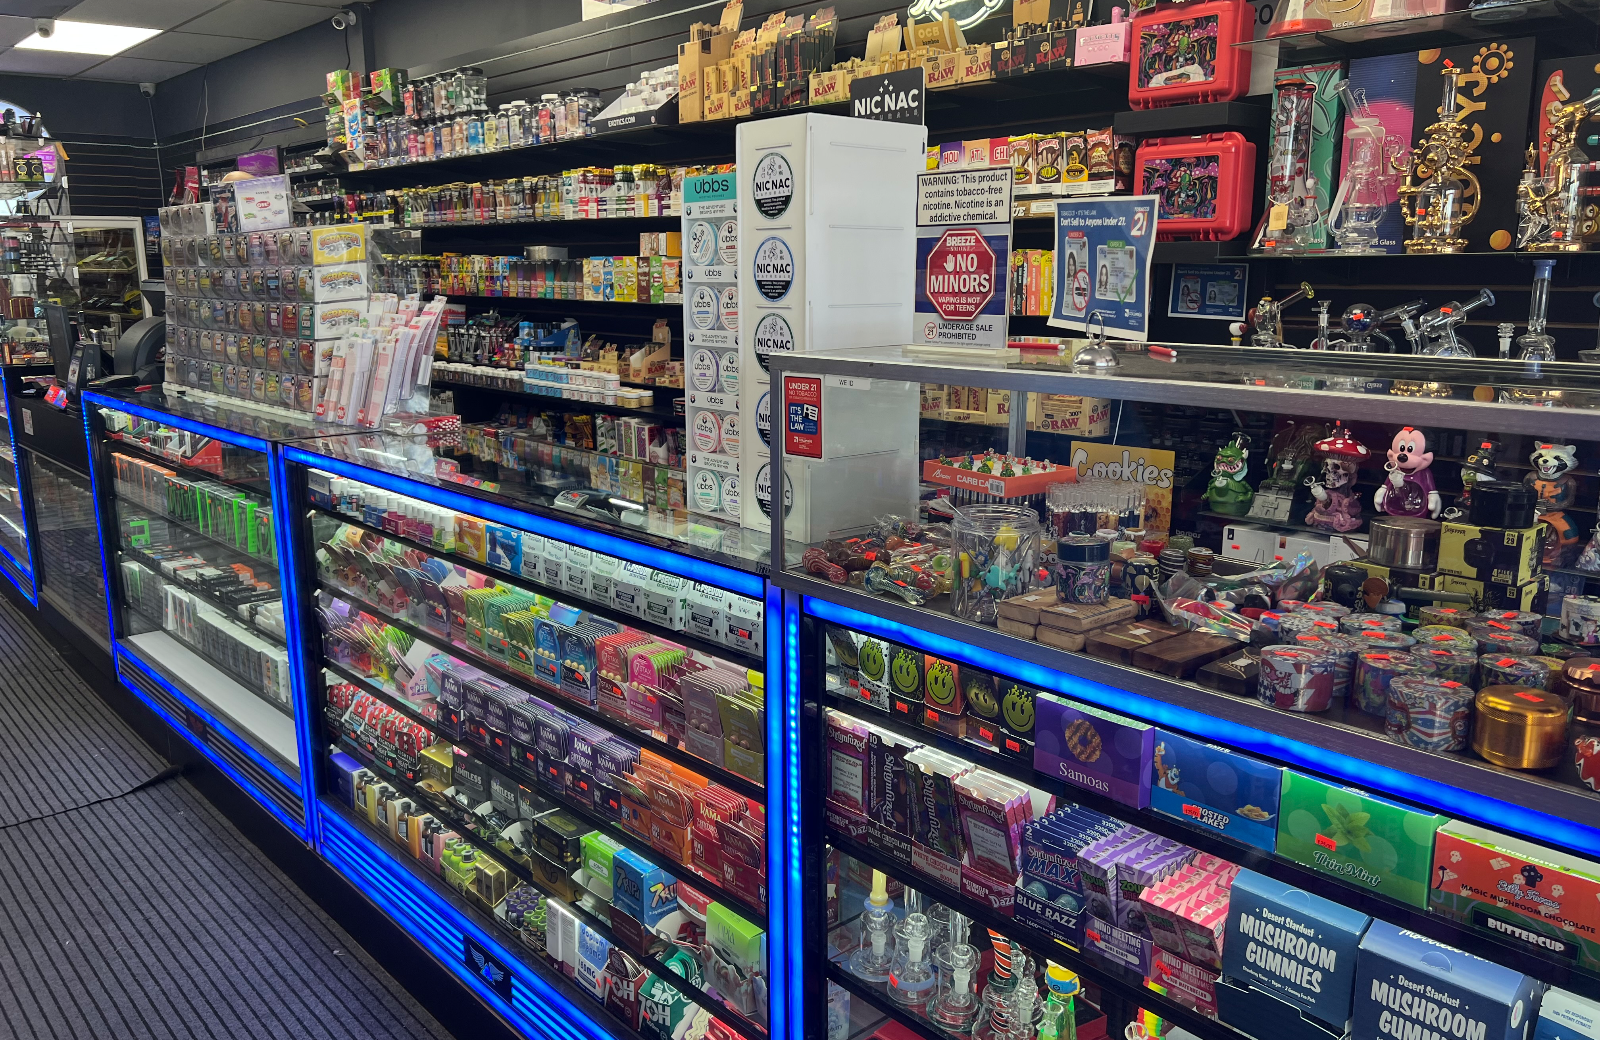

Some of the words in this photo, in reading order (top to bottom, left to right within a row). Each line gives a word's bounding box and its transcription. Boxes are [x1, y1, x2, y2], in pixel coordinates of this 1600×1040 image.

[874, 19, 897, 34] RAW
[918, 27, 939, 38] OCB
[733, 34, 755, 51] RAW
[1035, 45, 1068, 64] RAW
[965, 59, 991, 77] RAW
[997, 54, 1027, 71] RAW
[927, 66, 956, 84] RAW
[679, 79, 697, 96] RAW
[814, 82, 836, 98] RAW
[854, 96, 882, 116] NIC
[884, 89, 919, 111] NAC
[707, 103, 724, 118] RAW
[943, 150, 959, 165] HOU
[970, 148, 987, 162] ATL
[993, 147, 1009, 160] CHI
[755, 181, 770, 194] NIC
[771, 178, 790, 190] NAC
[921, 175, 959, 188] WARNING:
[961, 174, 976, 184] This
[978, 172, 1007, 185] product
[925, 188, 955, 198] contains
[956, 185, 1003, 196] tobacco-free
[923, 201, 953, 212] nicotine.
[954, 199, 985, 210] Nicotine
[986, 199, 993, 208] is
[993, 199, 1004, 208] an
[929, 211, 961, 223] addictive
[963, 210, 998, 221] chemical.
[1060, 217, 1071, 226] Don't
[1071, 216, 1080, 226] Sell
[1080, 217, 1085, 226] to
[1085, 217, 1103, 228] Anyone
[1103, 216, 1118, 226] Under
[1118, 216, 1127, 226] 21.
[319, 231, 361, 248] SCRATCH
[946, 235, 976, 247] BREEZE
[756, 263, 771, 274] NIC
[772, 263, 791, 274] NAC
[957, 253, 978, 271] NO
[320, 271, 362, 285] SCRATCH
[930, 273, 990, 294] MINORS
[938, 295, 960, 305] VAPING
[961, 296, 966, 304] IS
[967, 296, 980, 305] NOT
[320, 307, 360, 321] SCRATCH
[942, 303, 954, 312] FOR
[955, 303, 975, 313] TEENS
[938, 322, 973, 333] UNDERAGE
[975, 323, 993, 332] SALE
[938, 331, 977, 341] PROHIBITED
[757, 338, 772, 350] NIC
[772, 339, 791, 351] NAC
[648, 364, 667, 374] RAW
[788, 382, 810, 391] UNDER
[811, 382, 817, 391] 21
[796, 390, 818, 398] TOBACCO
[790, 406, 802, 414] IT'S
[921, 399, 941, 412] RAW
[790, 414, 803, 422] THE
[1088, 408, 1110, 424] RAW
[790, 422, 805, 431] LAW
[1050, 417, 1080, 431] RAW
[1072, 447, 1172, 489] Cookies
[957, 474, 978, 487] CARB
[1506, 537, 1515, 545] 29
[869, 732, 878, 744] 10
[904, 761, 914, 772] 10
[455, 765, 482, 787] LIMITLESS
[1059, 761, 1109, 794] Samoas
[490, 782, 516, 803] LIMITLESS
[1025, 826, 1033, 838] 2
[1027, 857, 1079, 887] MAX
[1313, 850, 1345, 876] Thin
[1345, 861, 1383, 888] Mint
[1525, 889, 1563, 910] Farms
[1016, 893, 1042, 915] BLUE
[1044, 909, 1078, 929] RAZZ
[1460, 883, 1488, 898] MAGIC
[1489, 893, 1543, 916] MUSHROOM
[1543, 911, 1596, 934] CHOCOLATE
[1262, 907, 1285, 926] Desert
[1285, 917, 1315, 938] Stardust
[1094, 918, 1112, 935] MIND
[1112, 926, 1141, 949] MELTING
[1487, 917, 1565, 952] BUTTERCUP
[1239, 912, 1337, 973] MUSHROOM
[1162, 952, 1182, 969] MIND
[1182, 962, 1214, 985] MELTING
[1245, 941, 1322, 994] GUMMIES
[1398, 974, 1425, 994] Desert
[1425, 985, 1460, 1009] Stardust
[1370, 978, 1487, 1040] MUSHROOM
